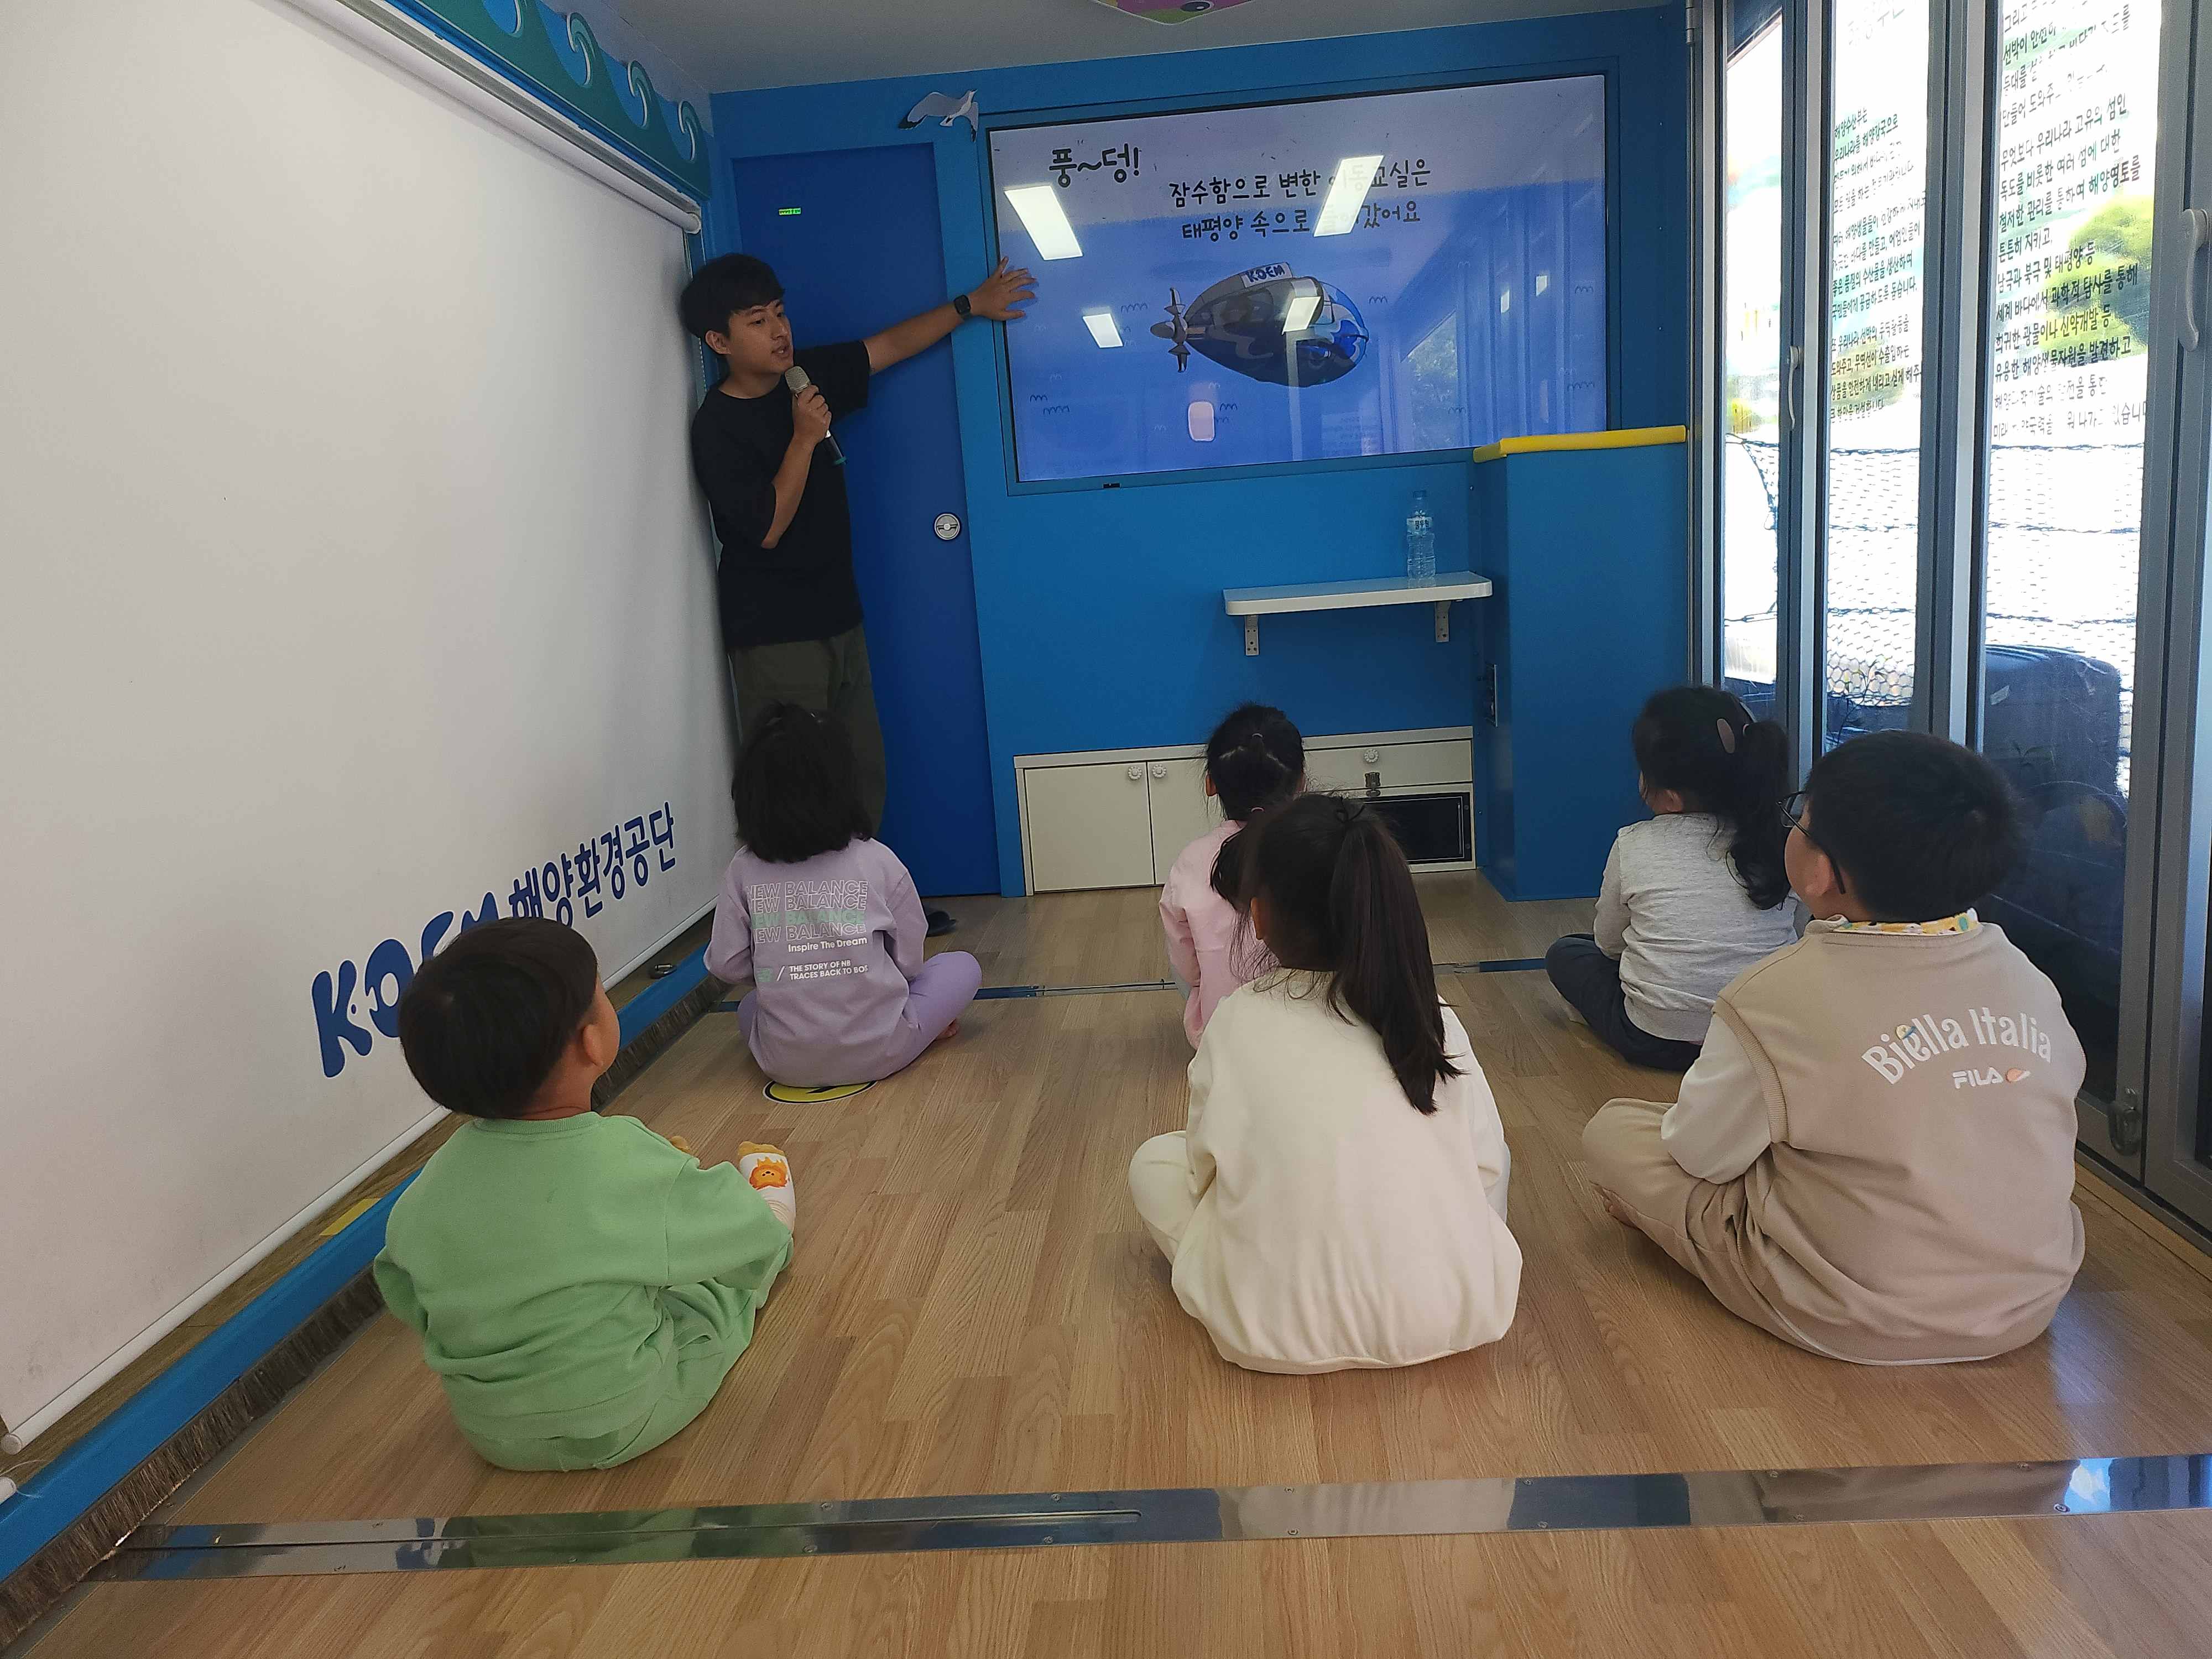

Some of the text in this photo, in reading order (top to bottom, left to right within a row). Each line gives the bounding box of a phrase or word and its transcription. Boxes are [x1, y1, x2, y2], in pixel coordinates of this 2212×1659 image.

[2004, 33, 2027, 66] 선박이
[1834, 107, 1867, 139] 해양수산부는
[2001, 93, 2127, 171] 무엇보다 우리나라 고유의 섬인
[1834, 135, 1860, 164] 우리나라를
[1863, 114, 1898, 147] 해양강국으로
[2000, 128, 2121, 201] 독도를 비롯한 여러 섬에 대한
[1168, 175, 1270, 208] 잠수함으로
[1279, 169, 1321, 198] 변한
[1999, 154, 2140, 233] 철저한 관리를 통하여 해양영토를
[1182, 215, 1243, 242] 태평양
[1251, 210, 1310, 238] 속으로
[1890, 220, 1920, 247] 어업인들이
[1998, 236, 2022, 263] 튼튼히
[1247, 264, 1285, 283] KOEM
[1833, 250, 1912, 297] 좋은 품질의 수산물을 생산하여
[1997, 241, 2095, 293] 남극과 북극 및 태평양 등
[1996, 263, 2138, 322] 세계 바다에서 과학적 탐사를 통해
[1832, 297, 1858, 321] 국민들에게
[1838, 331, 1859, 352] 우리나라
[1860, 326, 1877, 345] 선박의
[1995, 304, 2111, 354] 희귀한 광물이나 신약개발 등
[1855, 349, 1877, 372] 무역선이
[1995, 359, 2019, 383] 유용한
[1831, 381, 1846, 401] 상품을
[1848, 375, 1871, 397] 안전하게
[1873, 373, 1890, 392] 내리고
[508, 801, 676, 928] 해양환경공단
[785, 880, 868, 896] BALANCE
[785, 894, 868, 911] BALANCE
[786, 922, 867, 941] BALANCE
[788, 937, 868, 953] Inspire The Dream
[790, 971, 818, 980] TRACES
[820, 969, 841, 978] BACK
[804, 962, 828, 971] STORY
[1861, 1006, 2052, 1084] Biella Italia
[1952, 1067, 2004, 1089] FILA
